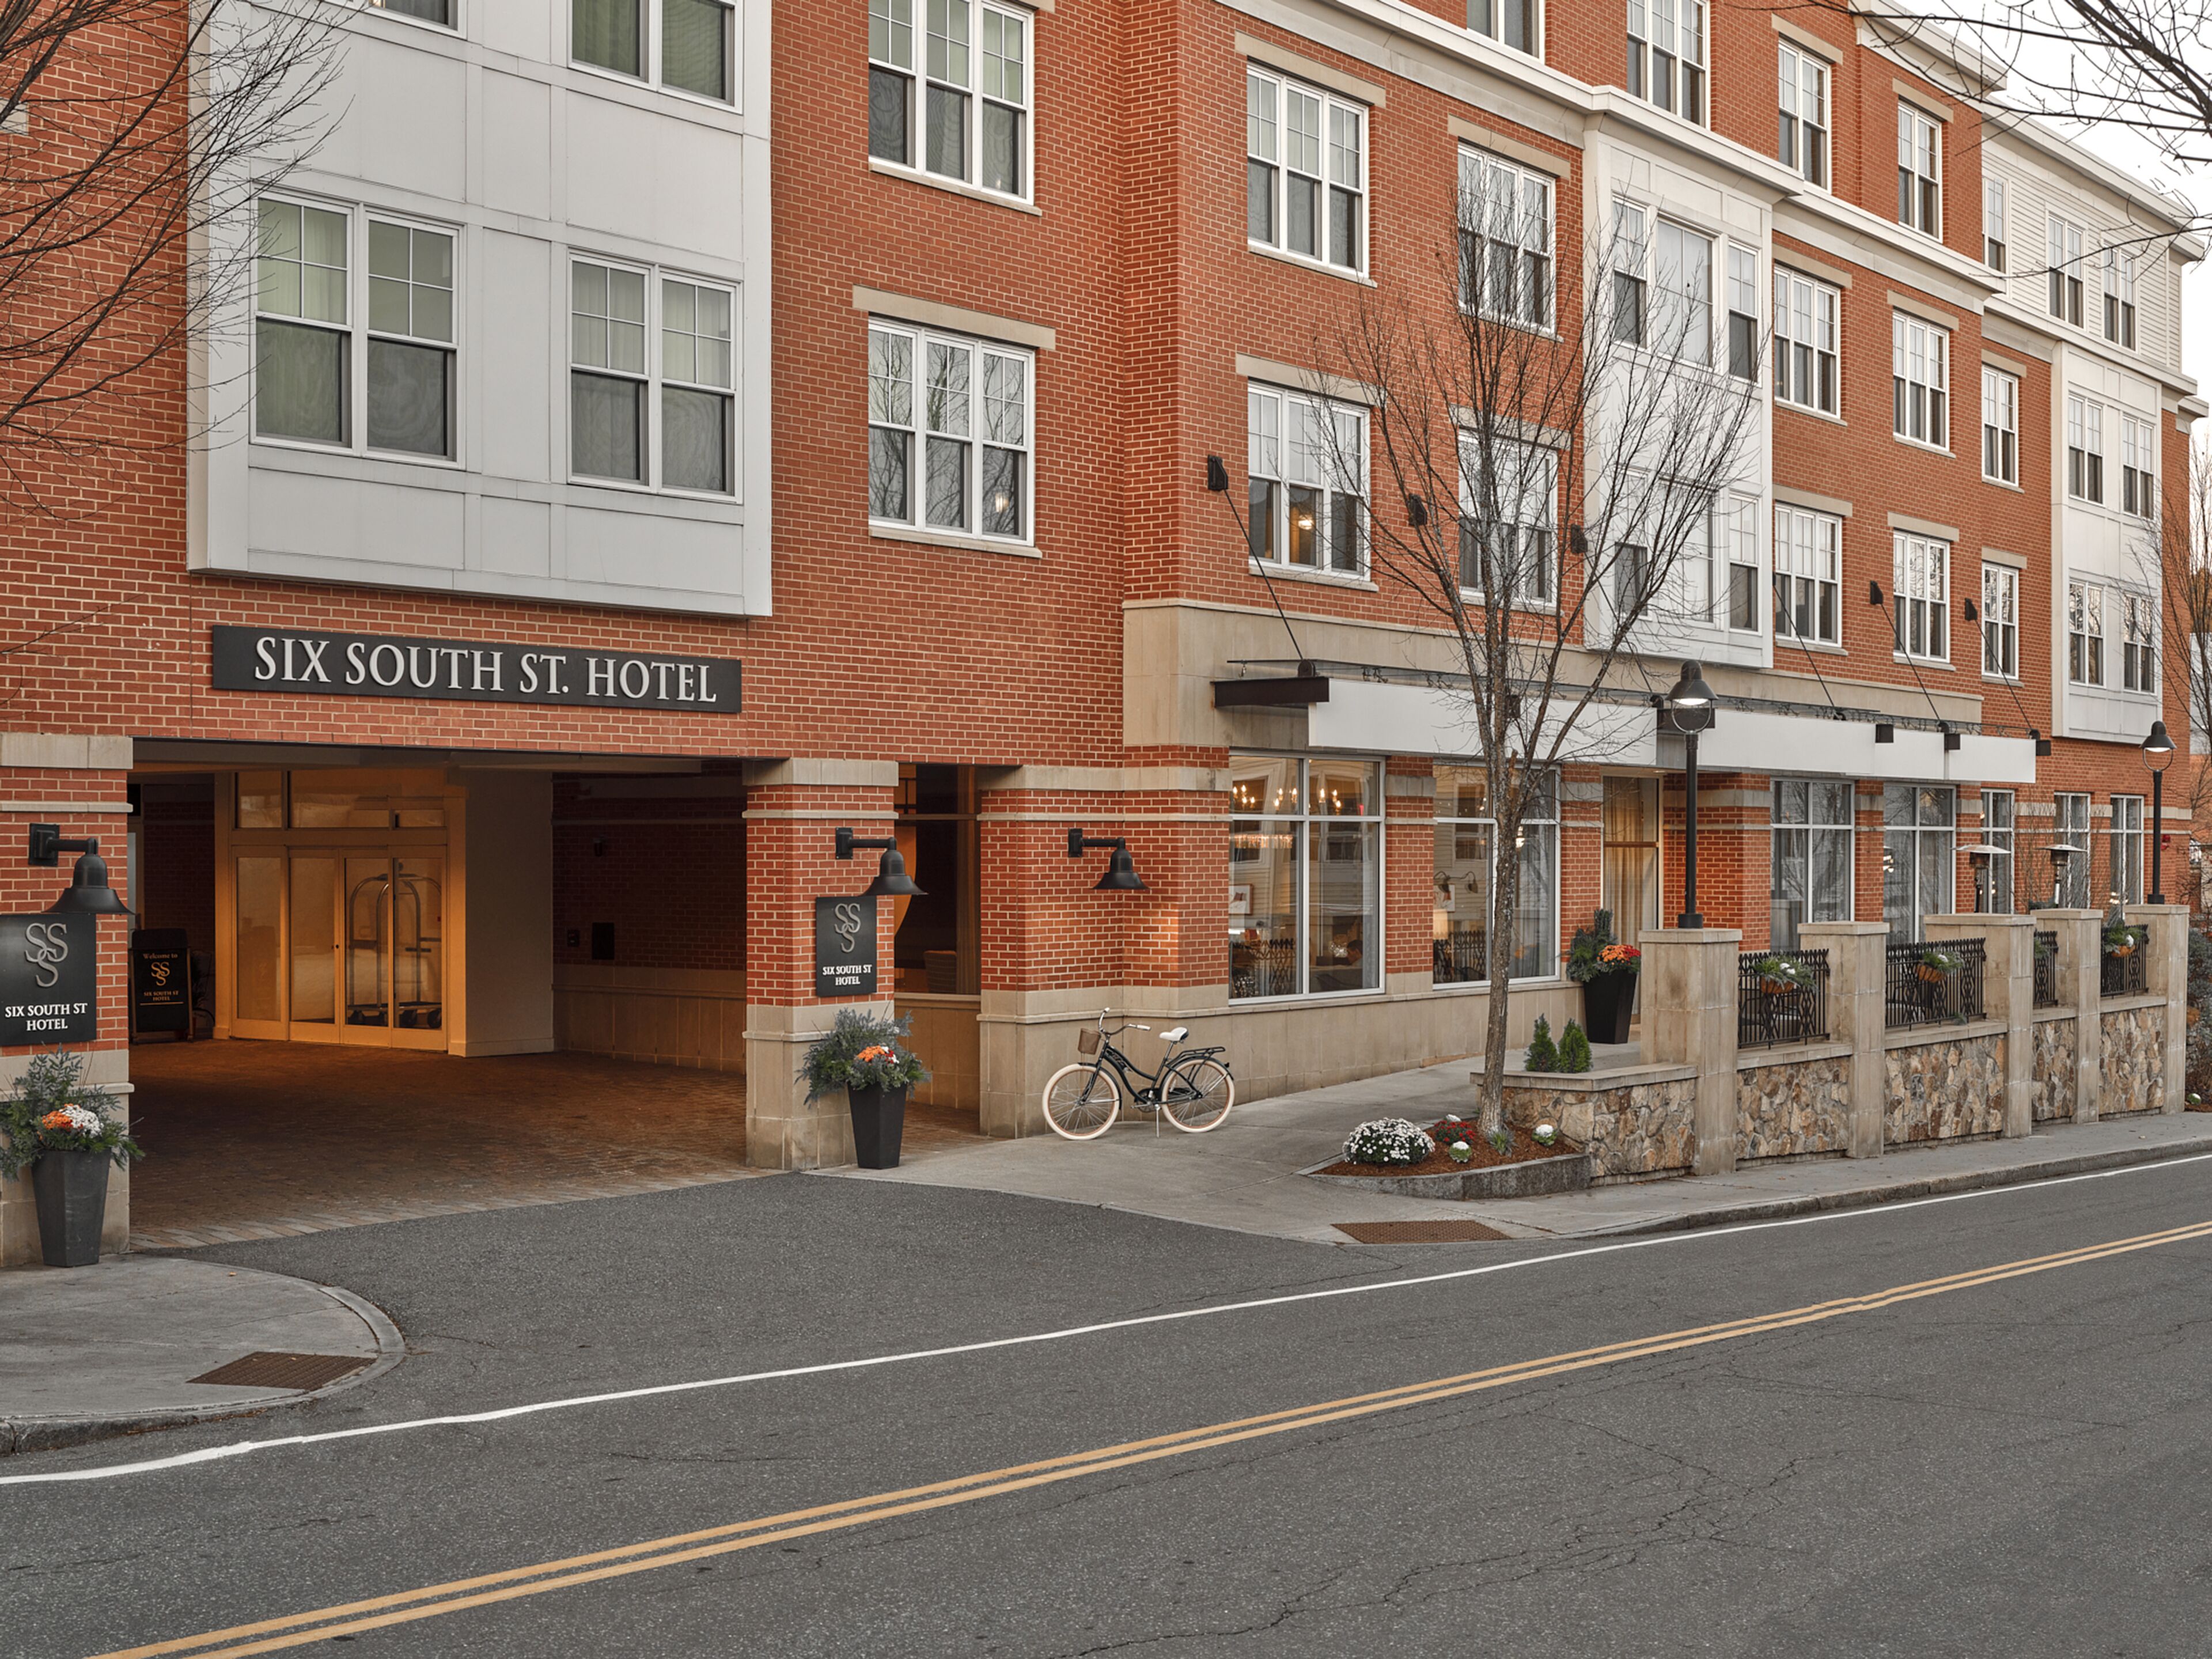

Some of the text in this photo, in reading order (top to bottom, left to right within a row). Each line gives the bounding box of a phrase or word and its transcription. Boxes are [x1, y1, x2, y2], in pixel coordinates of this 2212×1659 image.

[255, 637, 717, 703] SIX SOUTH ST. HOTEL
[823, 964, 872, 975] SIX SOUTH ST
[835, 976, 861, 986] HOTEL
[5, 1003, 88, 1017] SIX SOUTH ST
[26, 1018, 68, 1031] HOTEL
